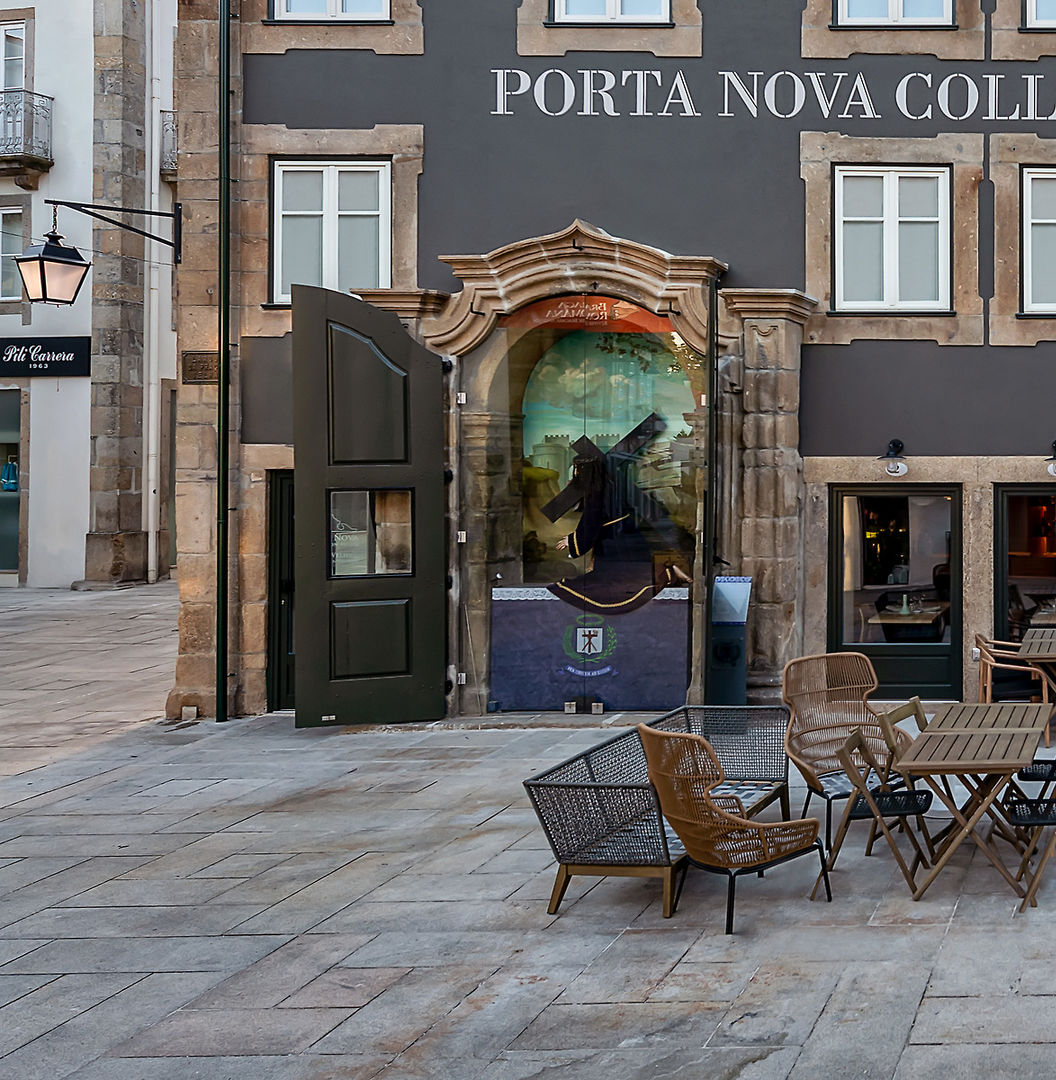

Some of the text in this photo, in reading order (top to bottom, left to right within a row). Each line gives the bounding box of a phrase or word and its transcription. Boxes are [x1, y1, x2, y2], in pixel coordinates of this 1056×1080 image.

[490, 68, 701, 117] PORTA
[717, 70, 882, 119] NOVA
[2, 344, 75, 362] Pili Carrera
